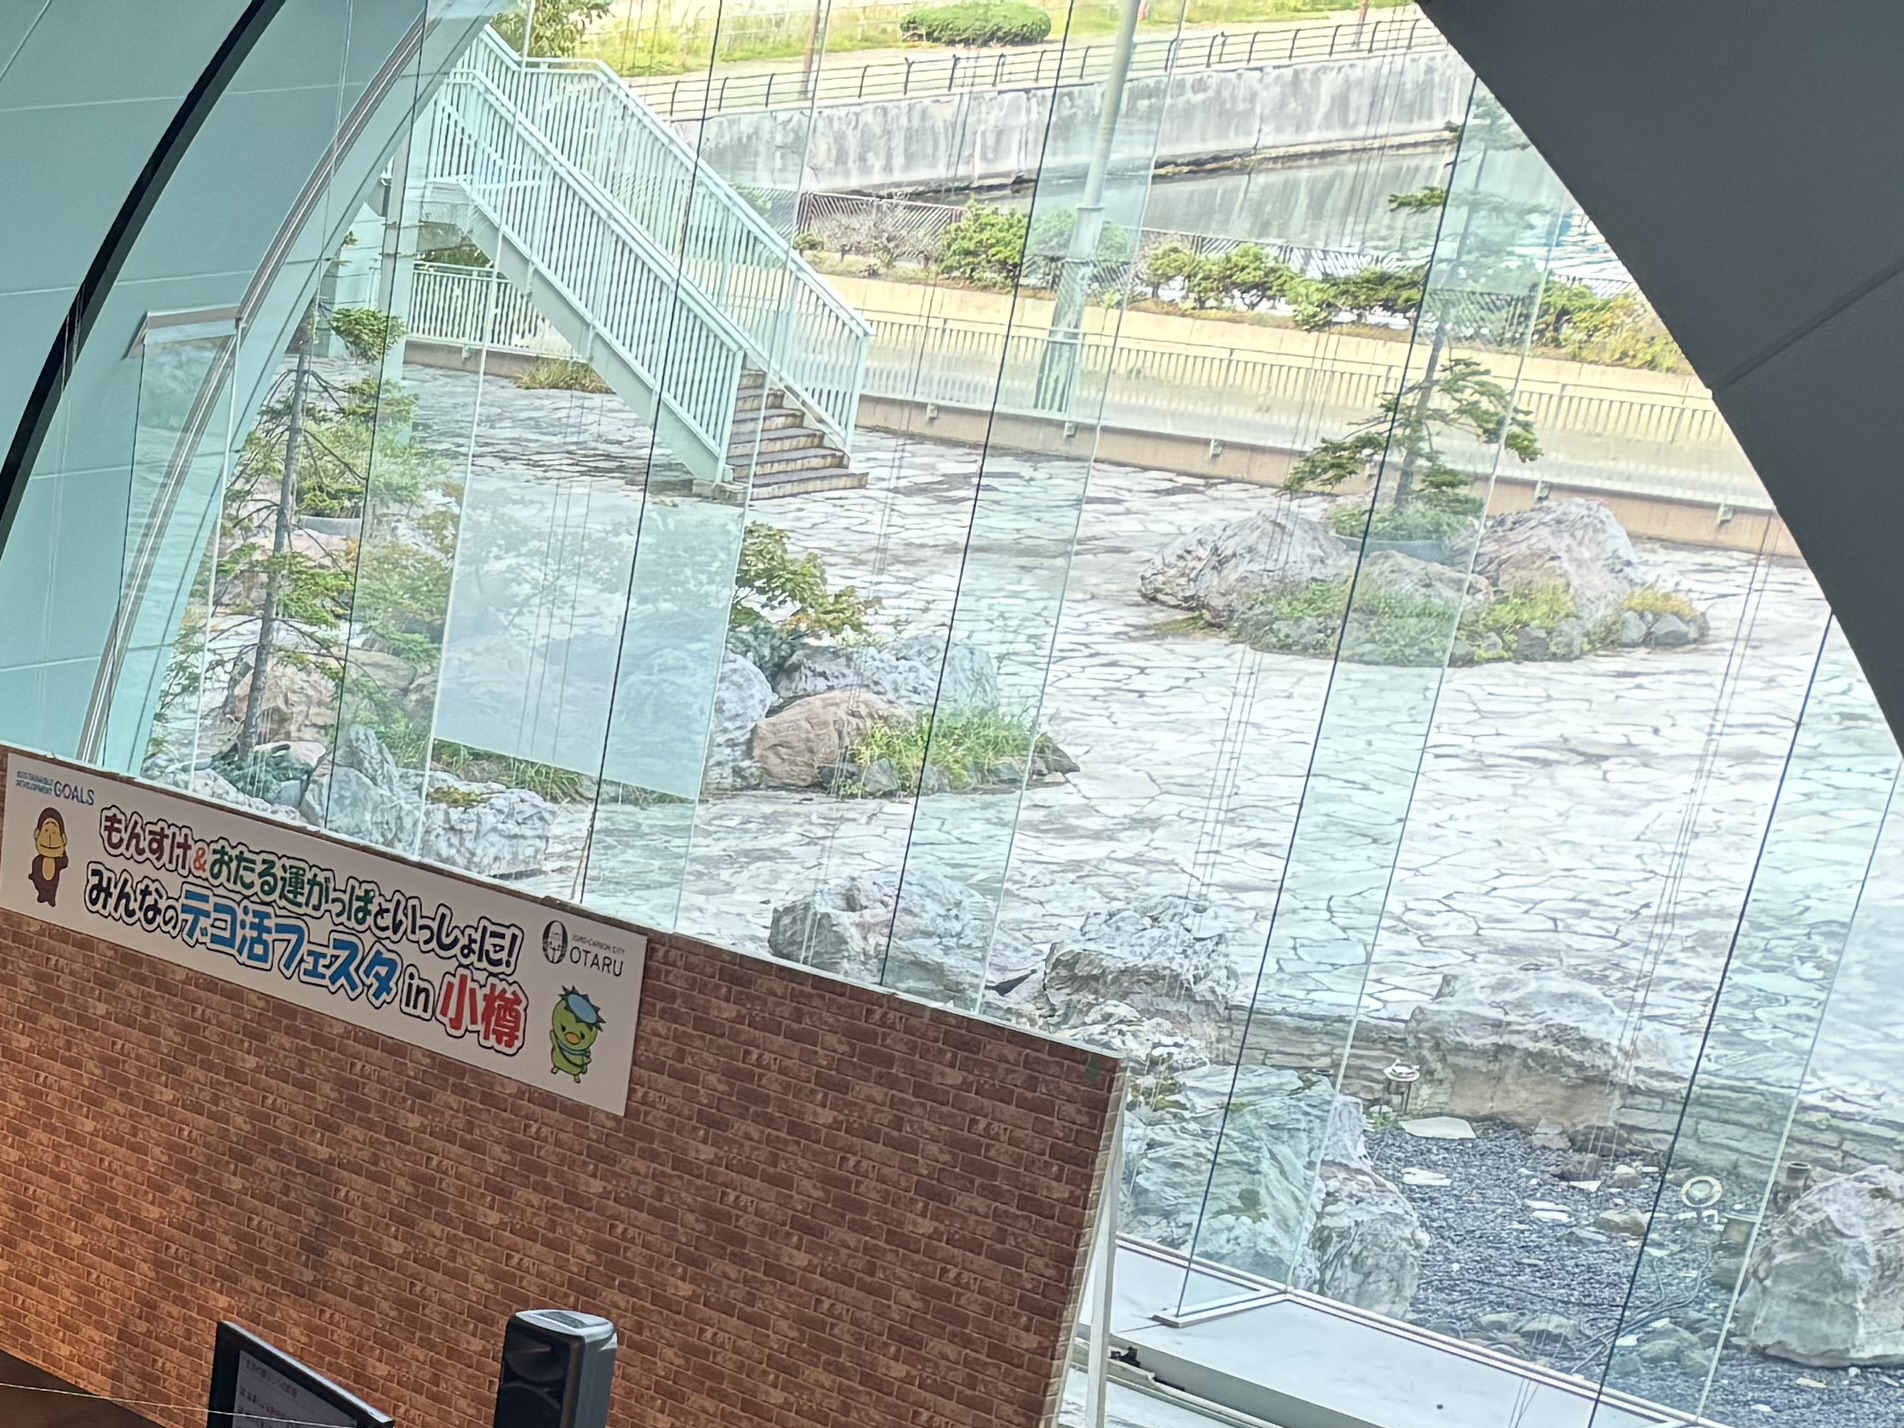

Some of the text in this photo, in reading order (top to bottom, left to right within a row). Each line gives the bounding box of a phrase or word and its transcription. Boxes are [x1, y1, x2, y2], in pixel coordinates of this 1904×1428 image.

[54, 781, 94, 806] GOALS
[570, 946, 624, 977] OTARU
[404, 972, 433, 1018] in
[439, 973, 527, 1050] 小樽
